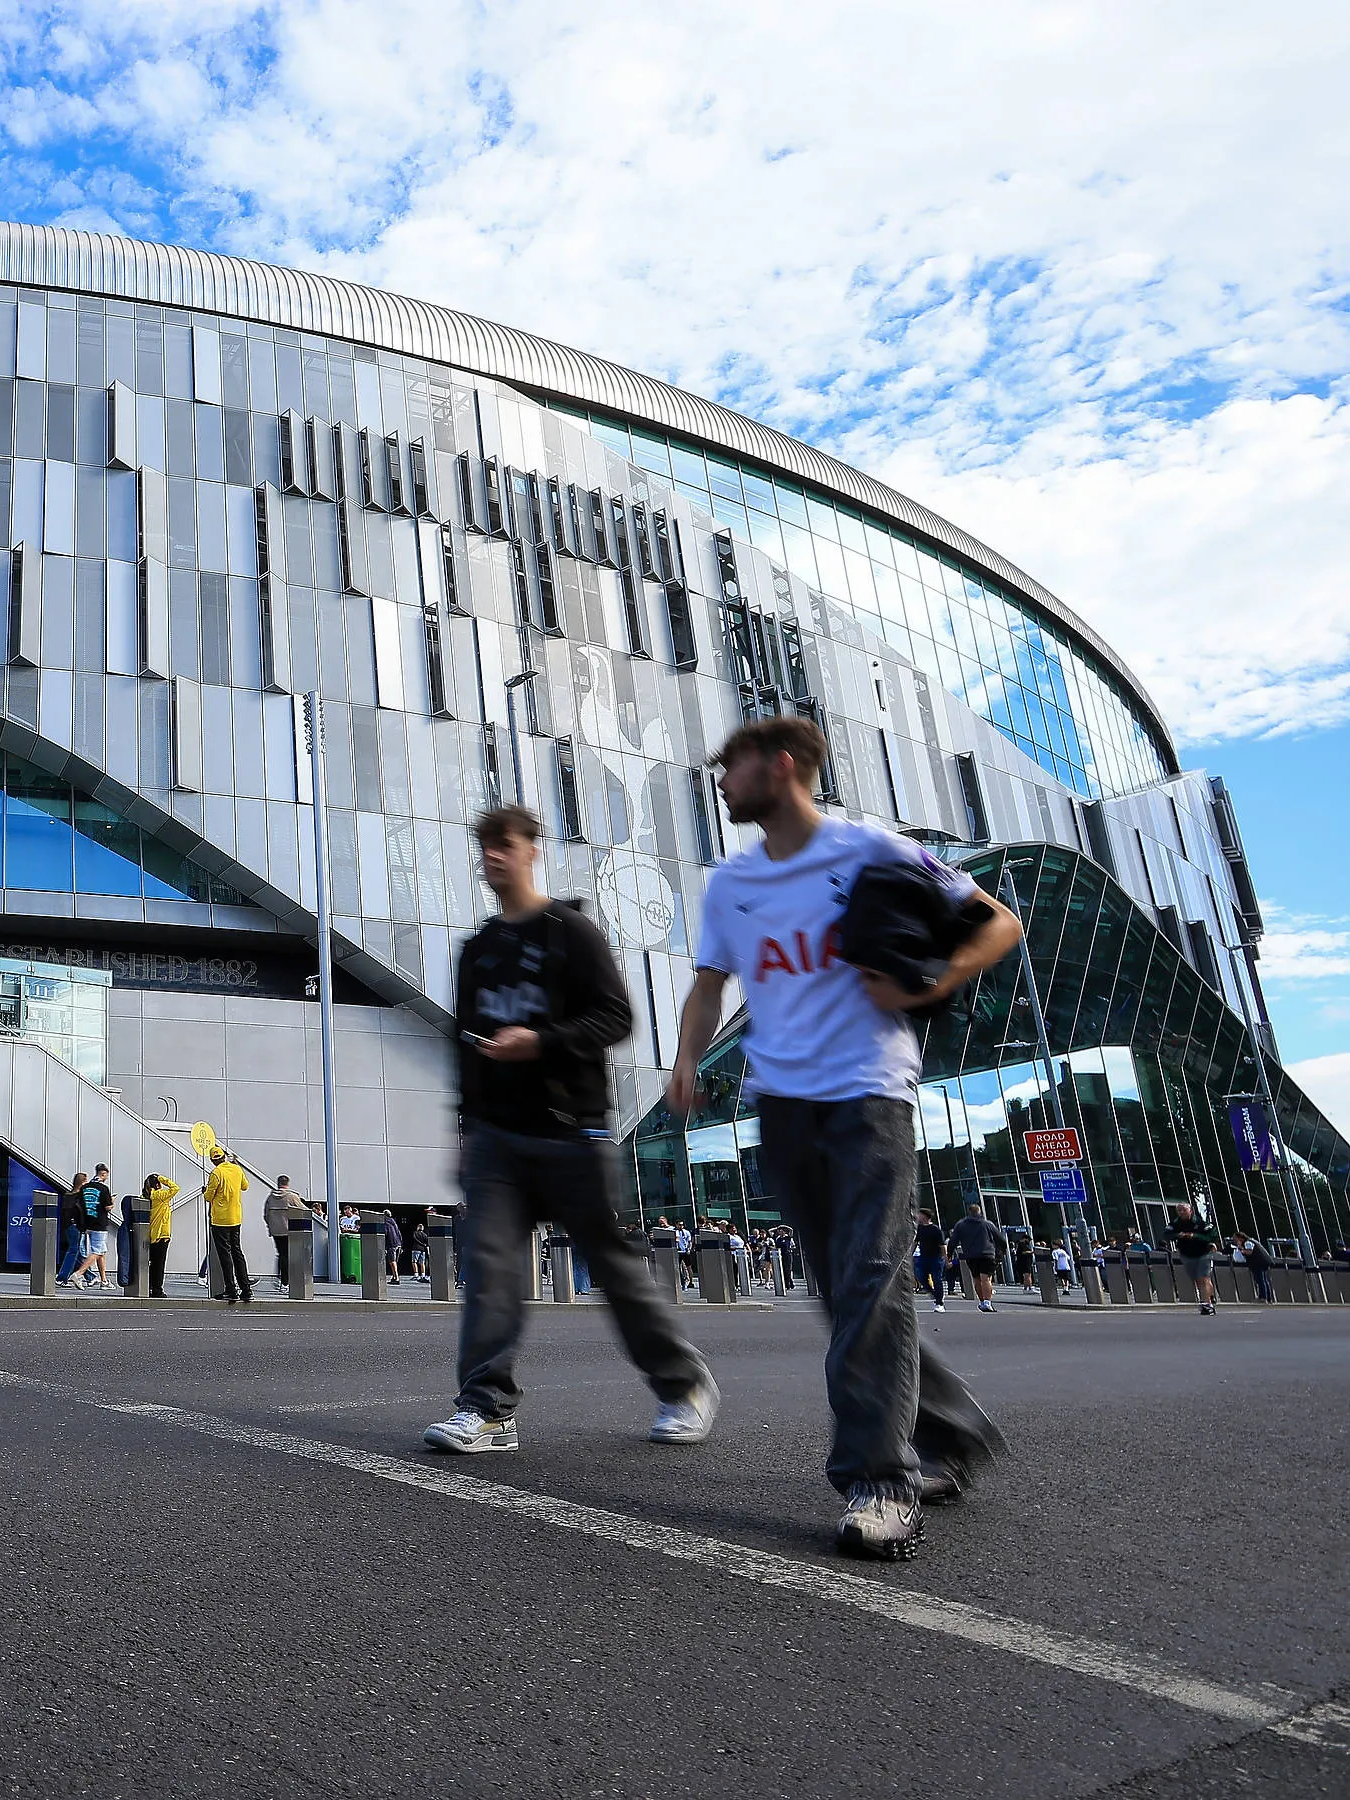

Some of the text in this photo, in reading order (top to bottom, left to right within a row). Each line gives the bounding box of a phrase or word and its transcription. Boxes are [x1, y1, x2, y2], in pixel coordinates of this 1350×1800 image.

[194, 957, 258, 987] 1882
[1036, 1132, 1065, 1142] ROAD
[1035, 1140, 1070, 1150] AHEAD
[1033, 1149, 1075, 1159] CLOSED
